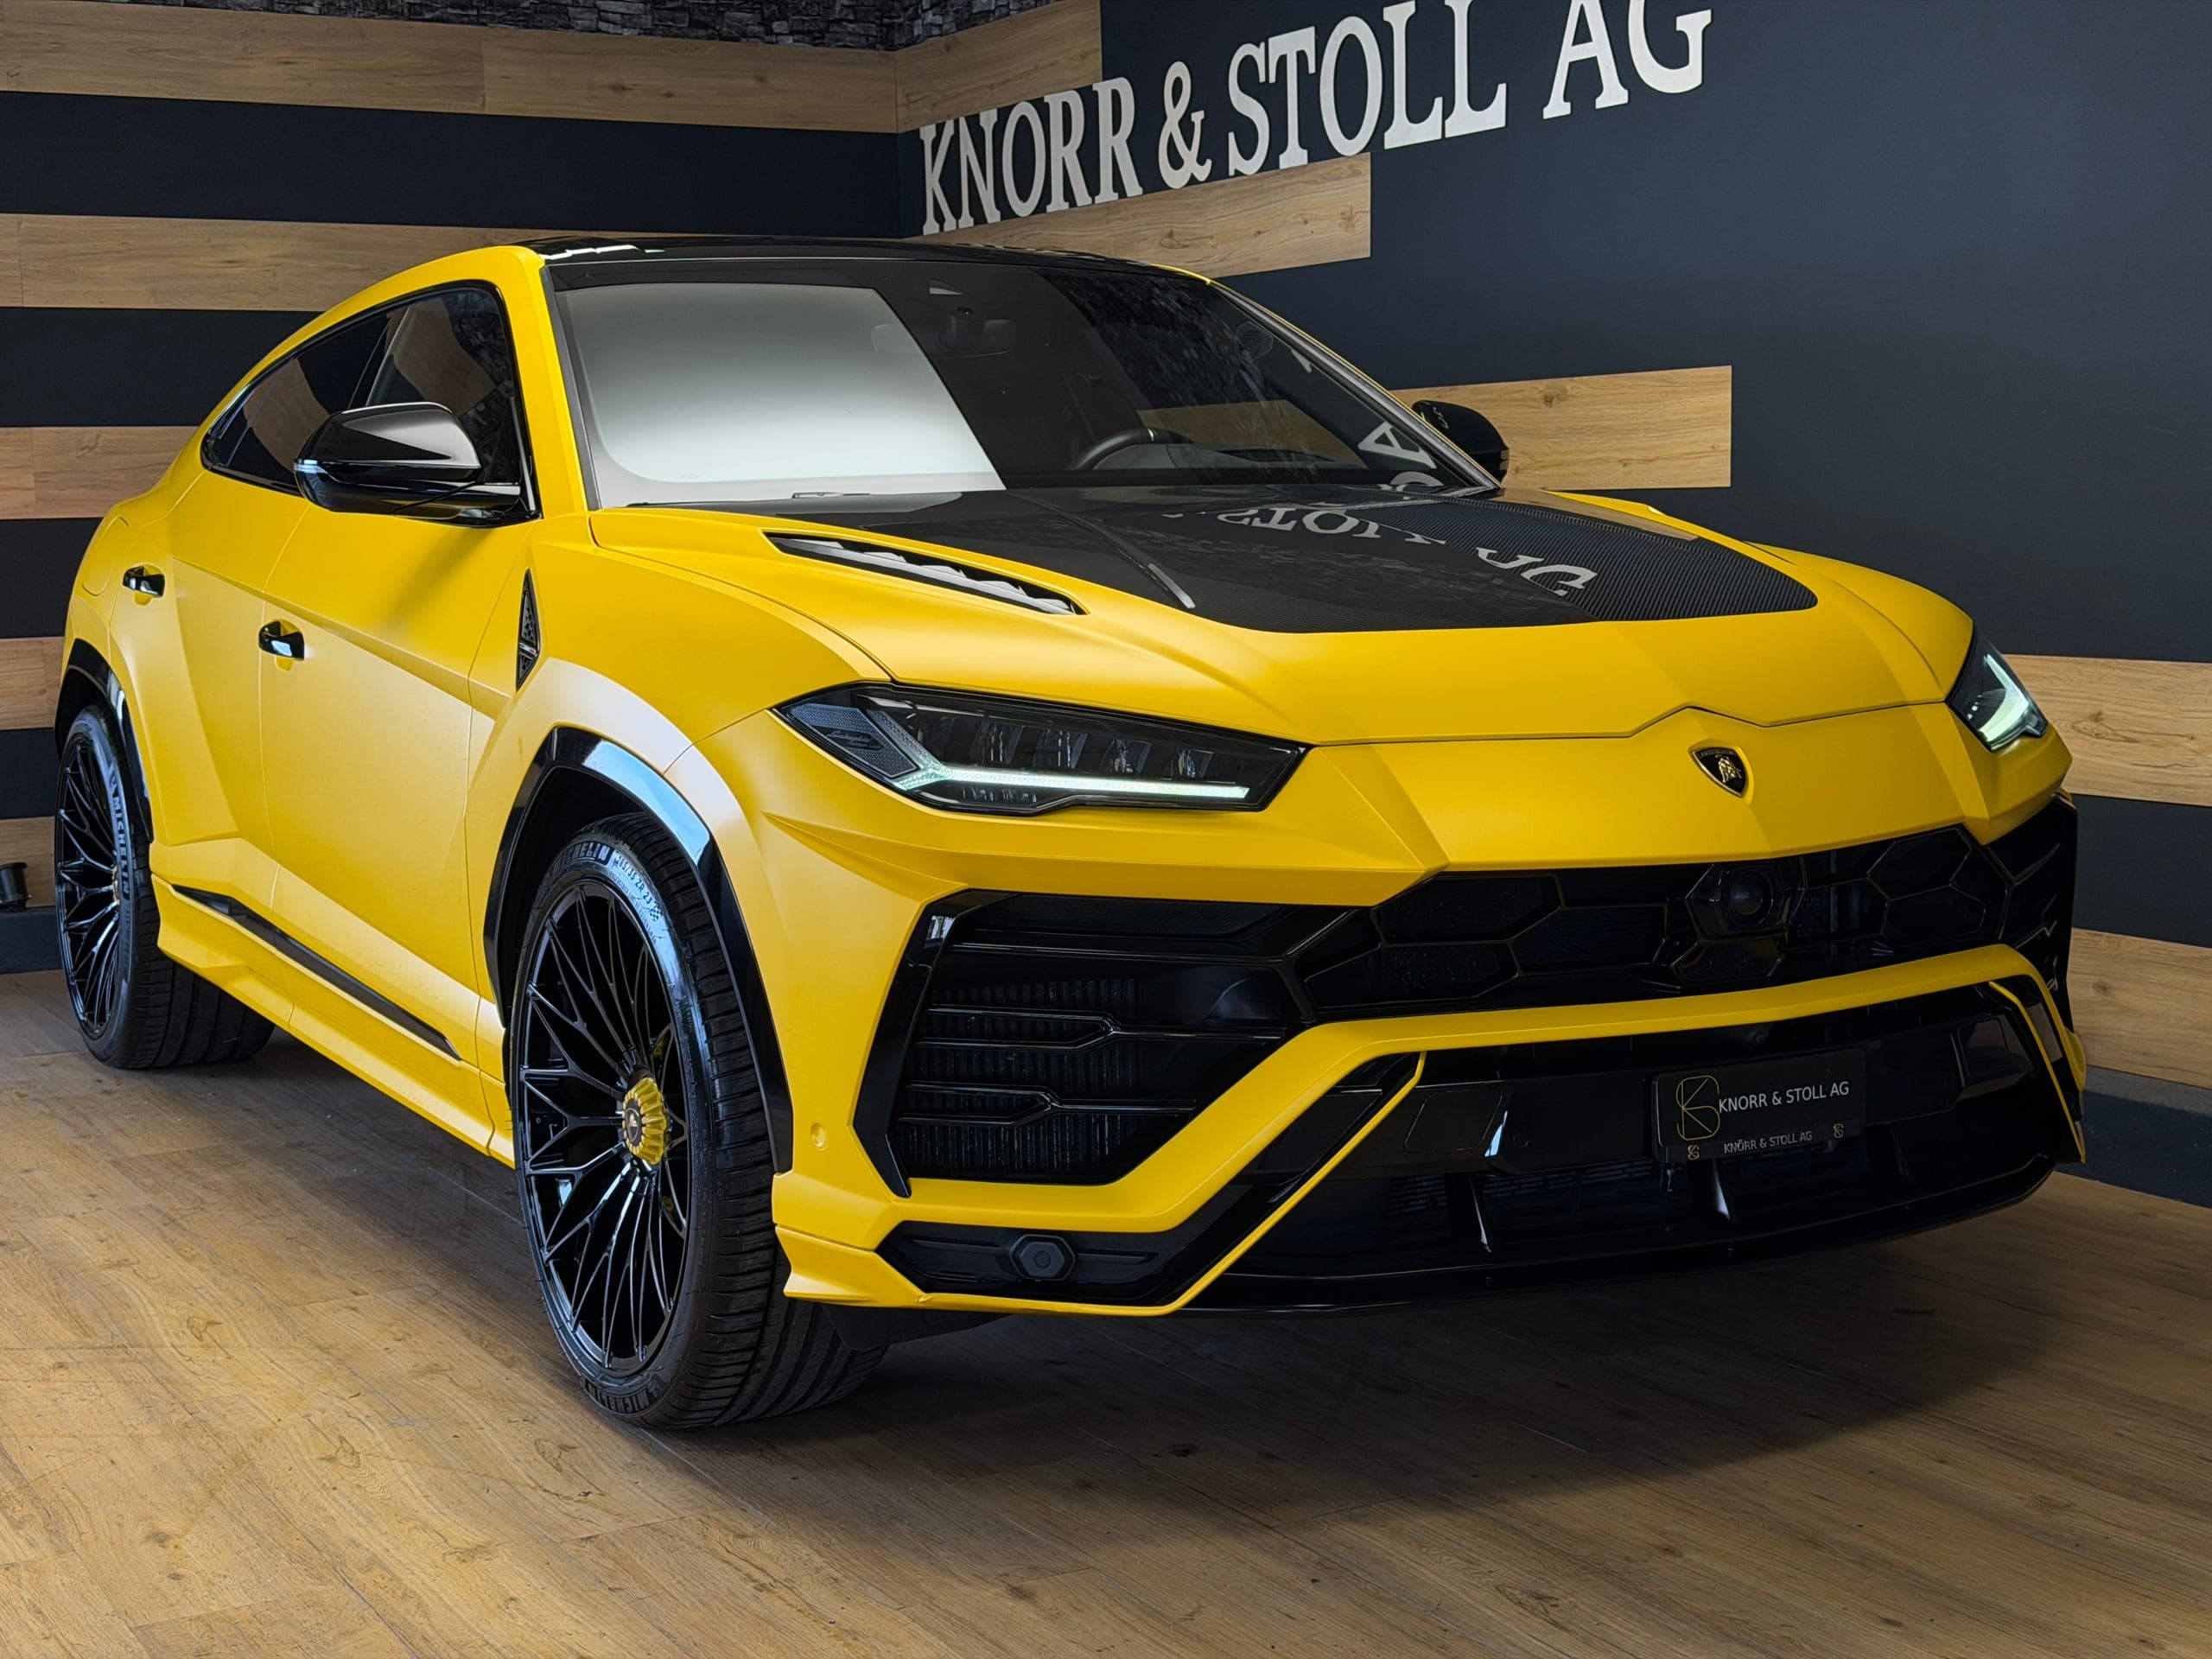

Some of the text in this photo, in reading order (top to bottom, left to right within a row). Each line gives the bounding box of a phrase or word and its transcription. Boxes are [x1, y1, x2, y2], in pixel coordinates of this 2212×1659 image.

[919, 0, 1713, 236] KNORR & STOLL AG
[113, 796, 130, 894] MICHELIN
[634, 879, 645, 893] ZR
[643, 891, 653, 905] 23
[1719, 1080, 1850, 1114] KNORR & STOLL AG
[1759, 1137, 1768, 1148] &
[1769, 1133, 1798, 1147] STOLL
[1799, 1130, 1813, 1142] AG
